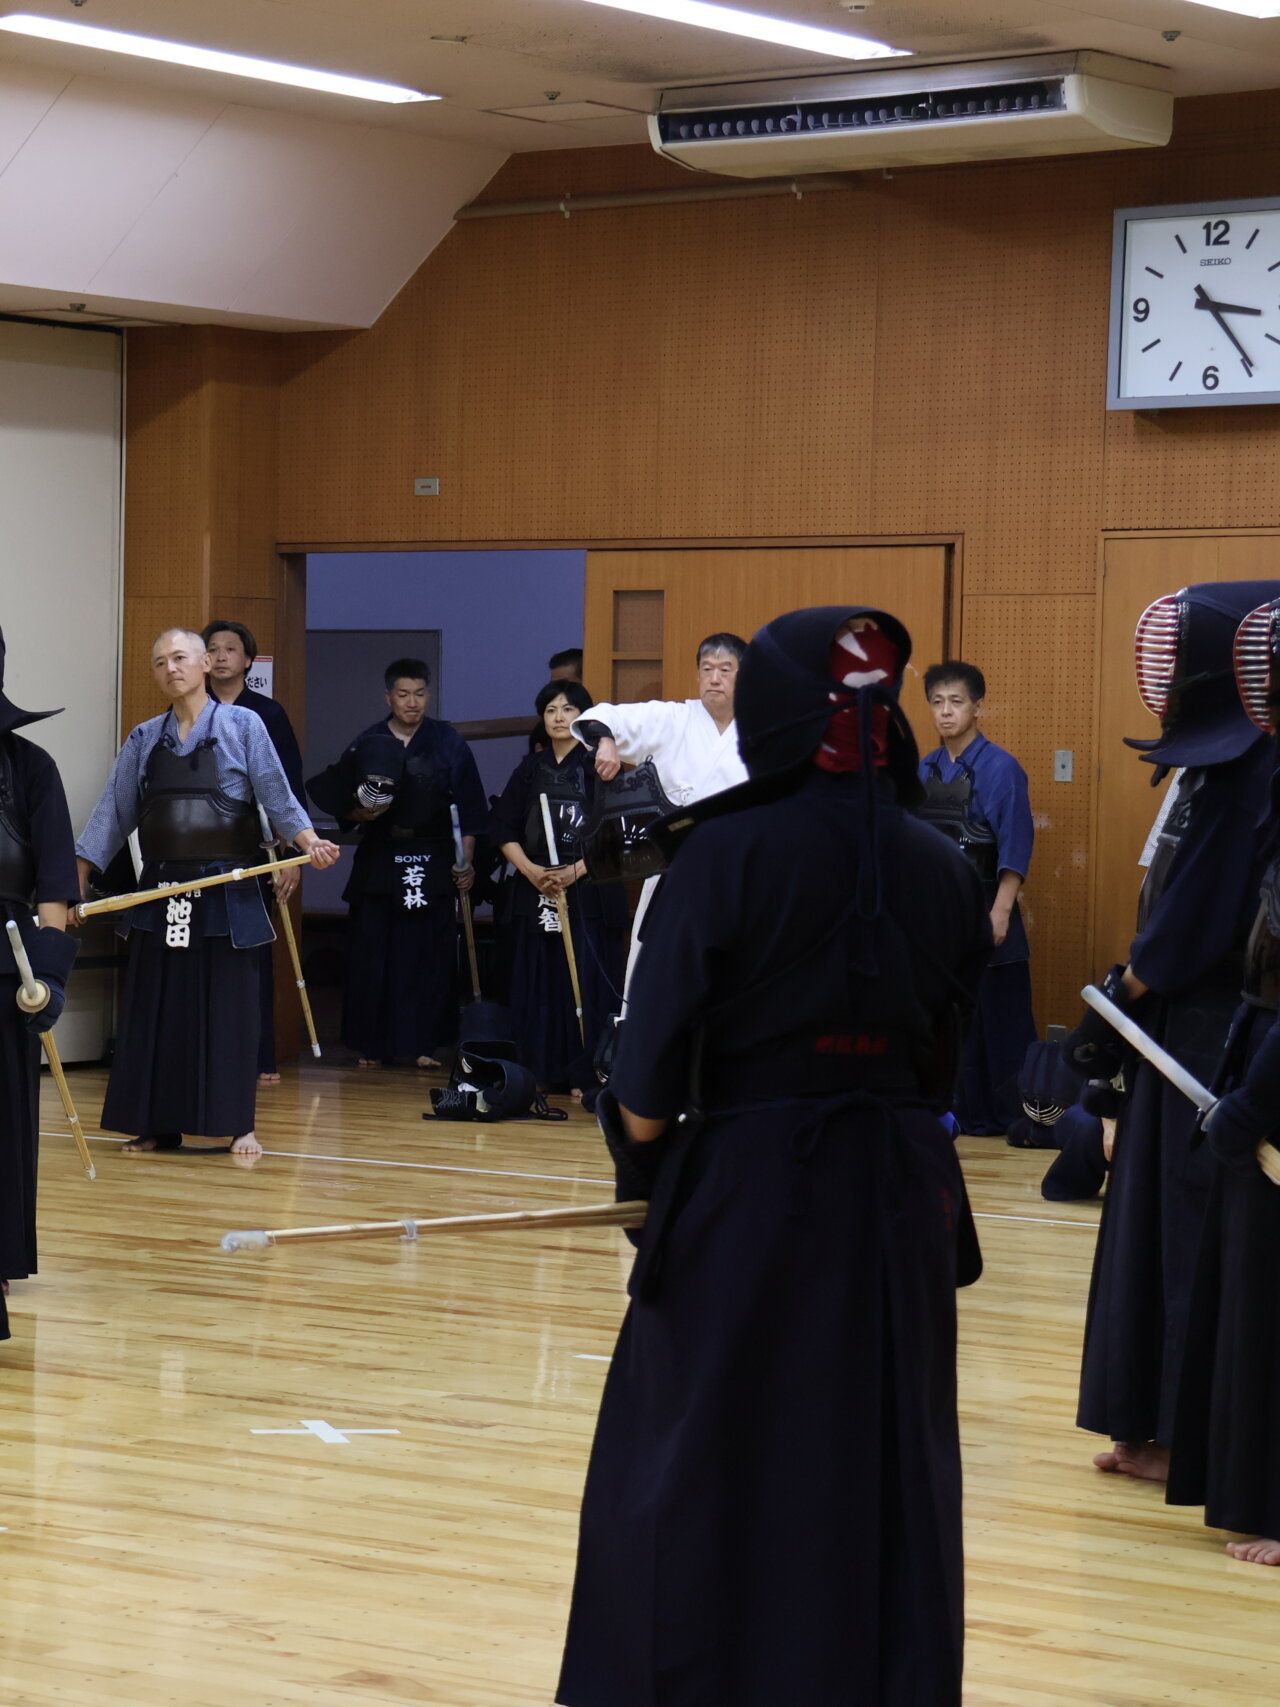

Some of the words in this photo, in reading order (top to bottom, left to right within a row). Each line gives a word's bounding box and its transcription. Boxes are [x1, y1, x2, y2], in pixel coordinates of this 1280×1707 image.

[1202, 220, 1230, 246] 12
[1200, 257, 1231, 267] SEIKO
[1133, 298, 1149, 322] 9
[1202, 365, 1219, 390] 6
[394, 855, 431, 863] SONY
[401, 864, 428, 910] 若林
[165, 897, 192, 948] 池田
